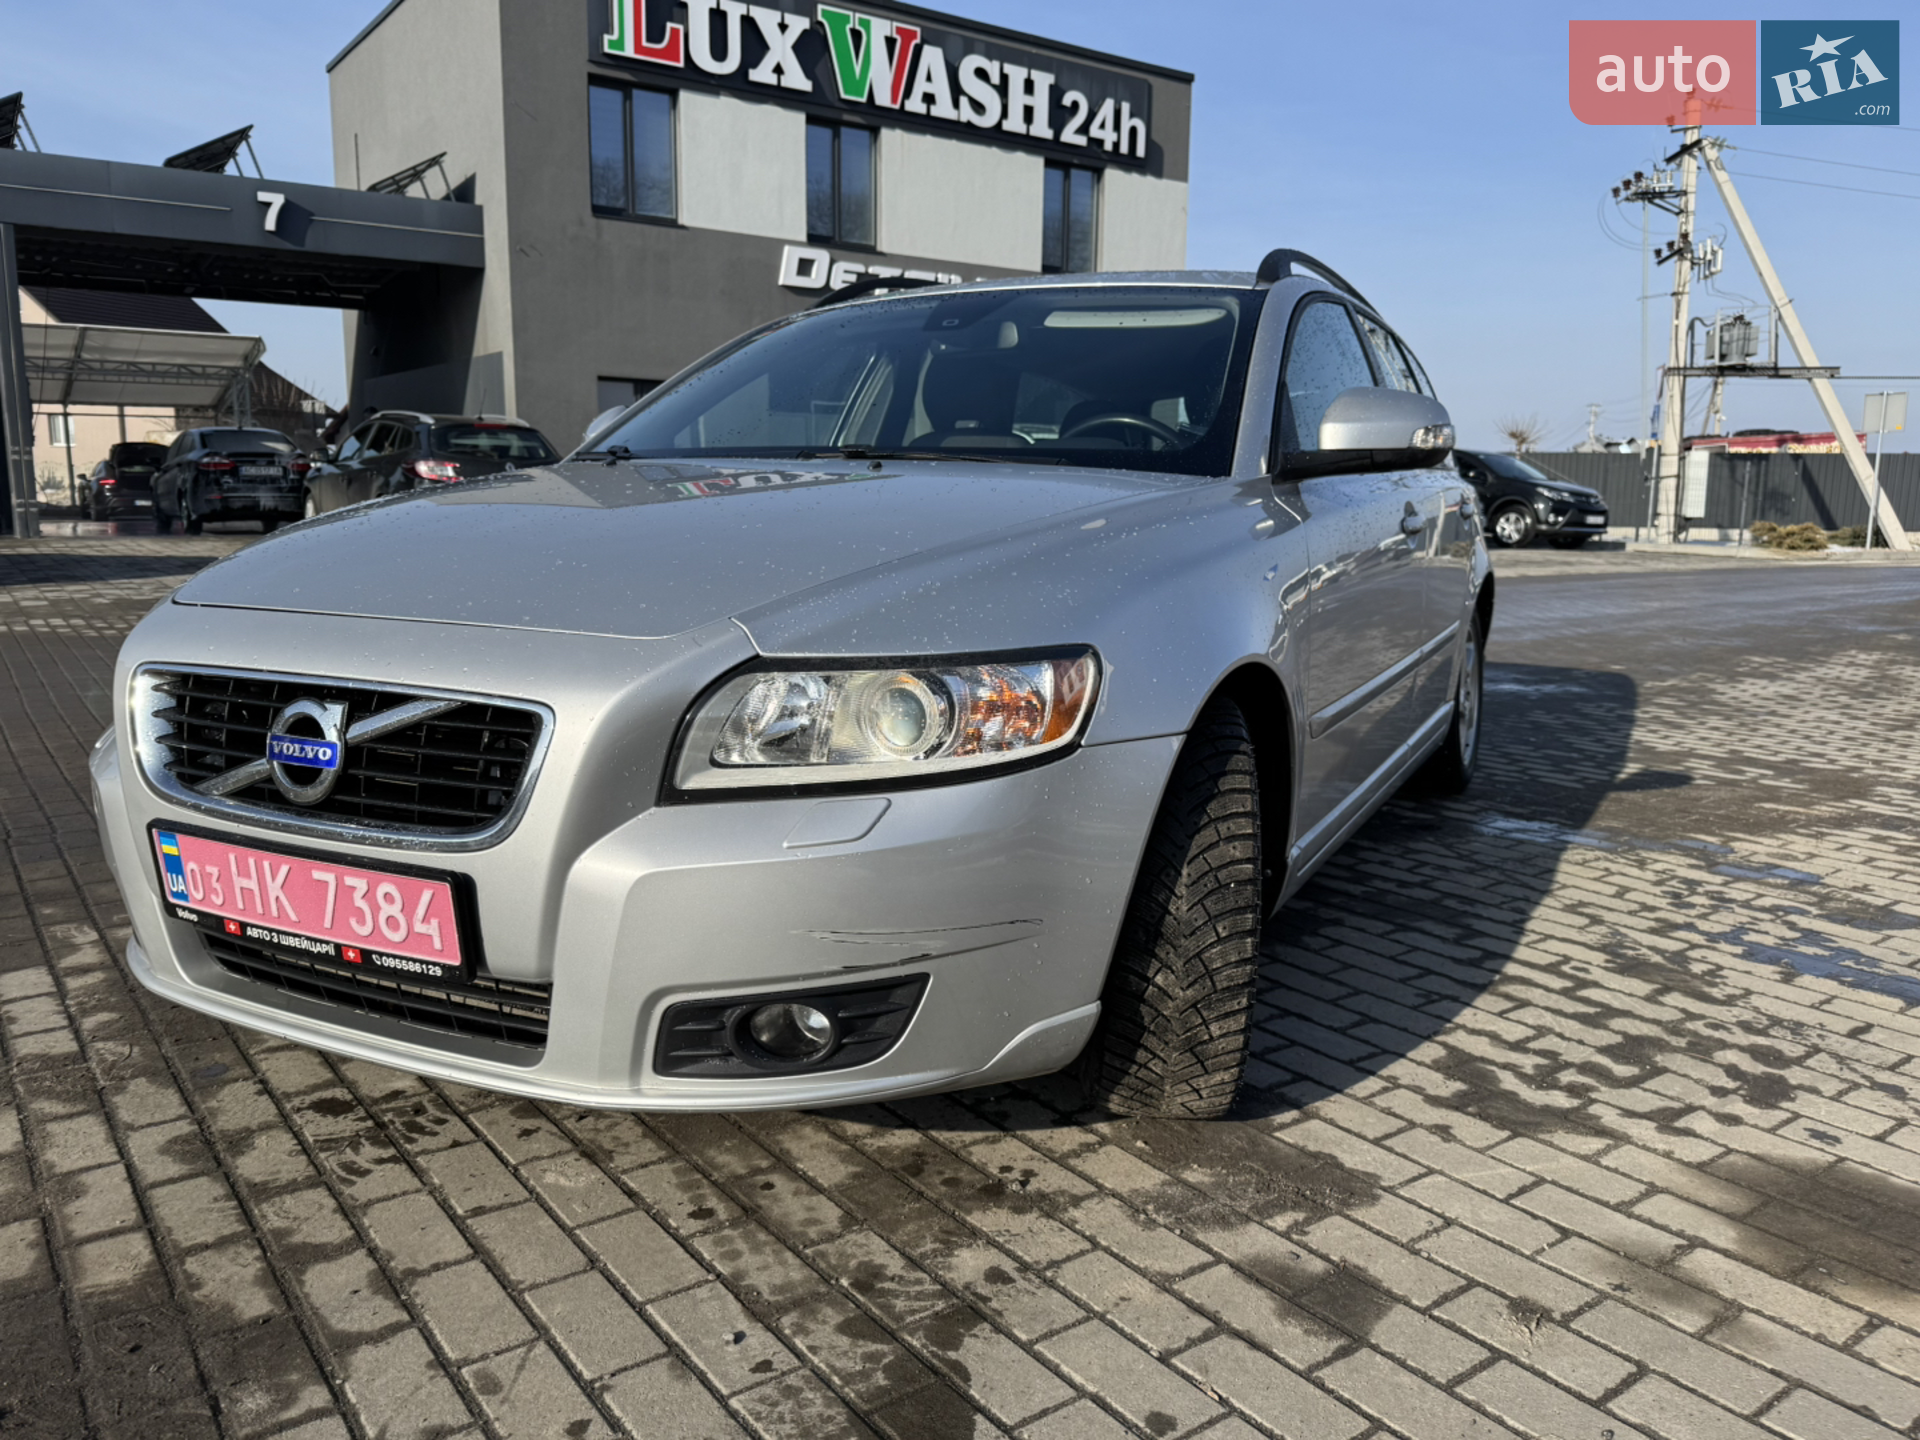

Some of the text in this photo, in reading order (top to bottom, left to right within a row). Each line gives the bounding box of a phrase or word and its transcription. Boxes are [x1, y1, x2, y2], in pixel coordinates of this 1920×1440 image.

[1059, 90, 1147, 159] 24h
[257, 191, 285, 232] 7
[271, 741, 332, 761] VOLVO
[167, 873, 188, 895] UA
[186, 861, 225, 907] 03
[311, 869, 444, 951] 7384
[246, 926, 271, 942] АВТО
